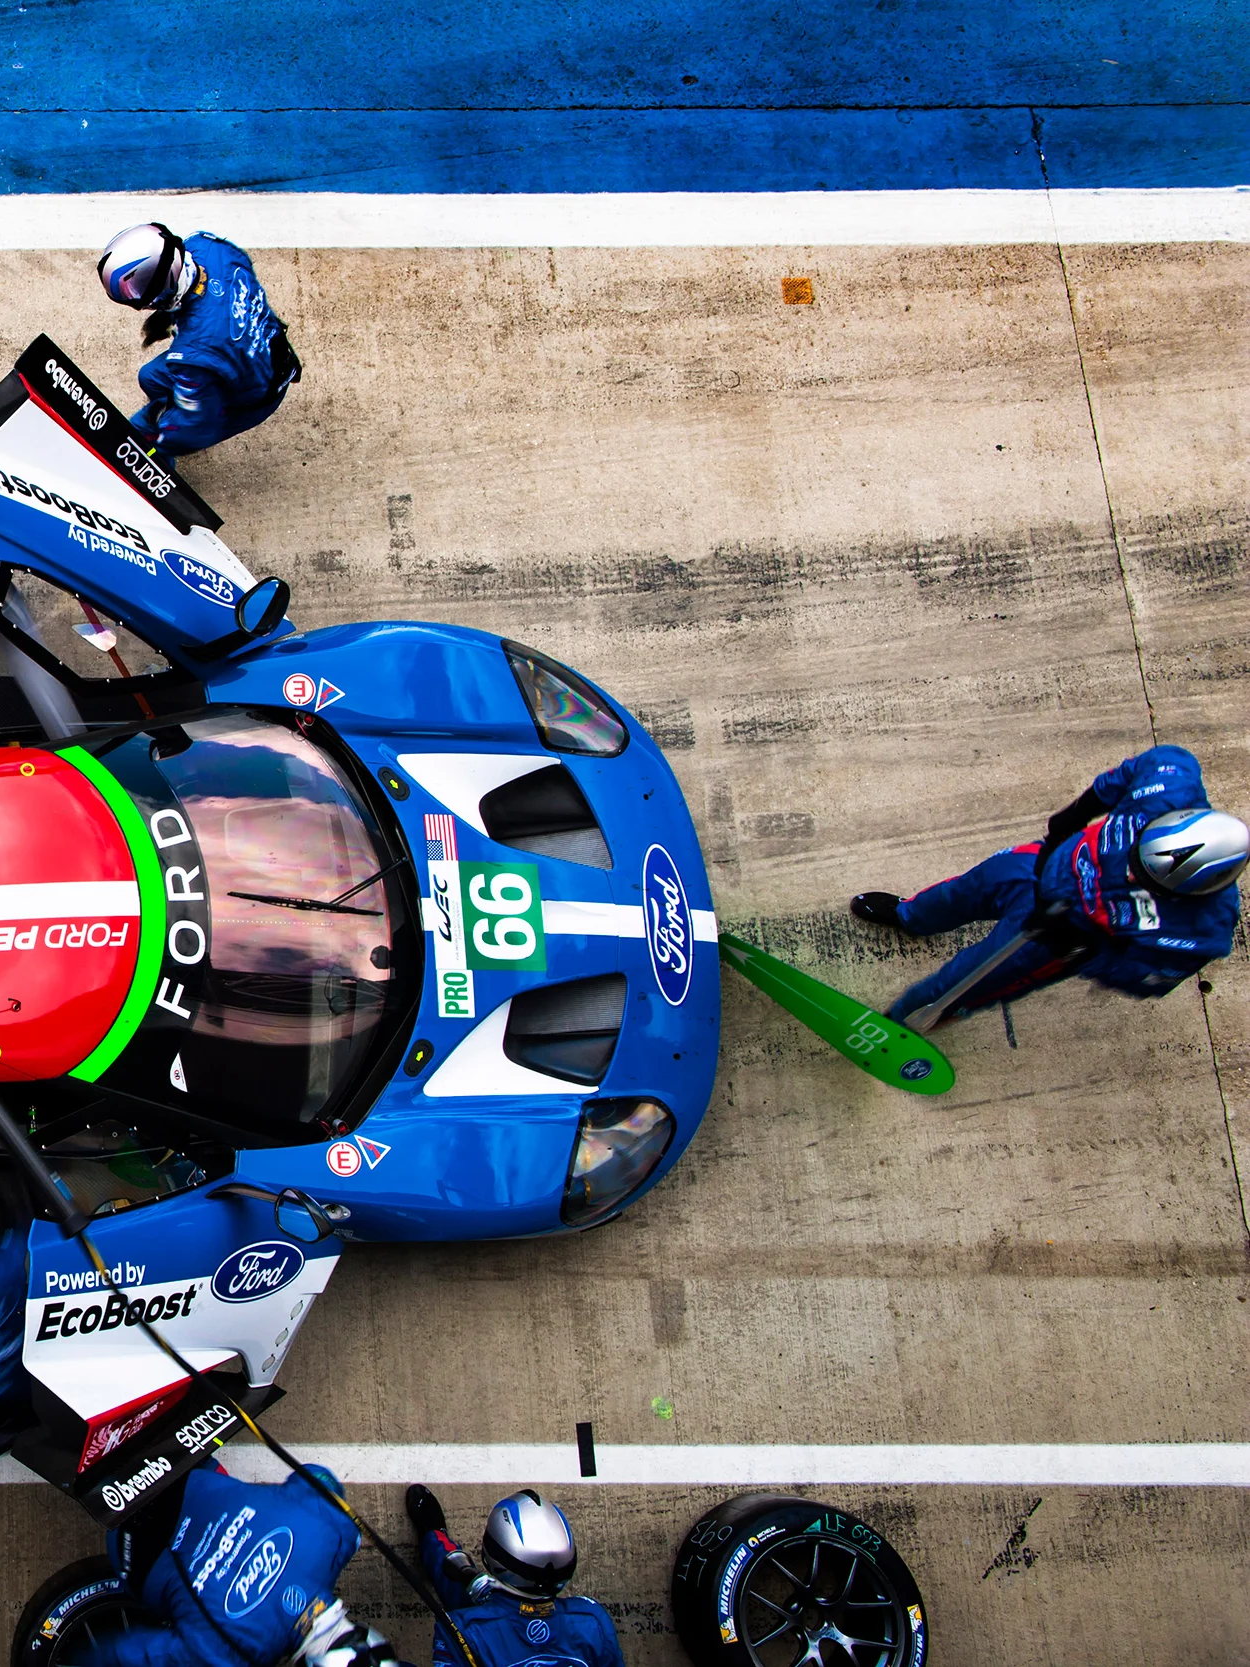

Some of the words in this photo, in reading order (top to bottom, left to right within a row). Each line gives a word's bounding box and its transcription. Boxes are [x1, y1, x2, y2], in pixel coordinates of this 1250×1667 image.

[45, 359, 96, 417] brembo
[116, 441, 173, 499] sparco
[67, 522, 88, 549] by
[91, 534, 157, 577] Powered
[178, 556, 235, 604] Ford
[150, 807, 207, 1020] FORD
[432, 873, 452, 942] WEC
[471, 872, 538, 962] 66
[652, 875, 688, 976] Ford
[43, 921, 129, 949] FORD
[442, 971, 469, 1015] PRO
[126, 1261, 146, 1287] by
[228, 1249, 290, 1295] Ford
[35, 1283, 198, 1342] EcoBoost
[175, 1404, 232, 1452] sparco
[113, 1456, 173, 1503] brembo
[192, 1504, 257, 1597] EcoBoost
[851, 1524, 882, 1552] 693
[236, 1539, 282, 1604] Ford
[720, 1546, 748, 1617] MICHELIN
